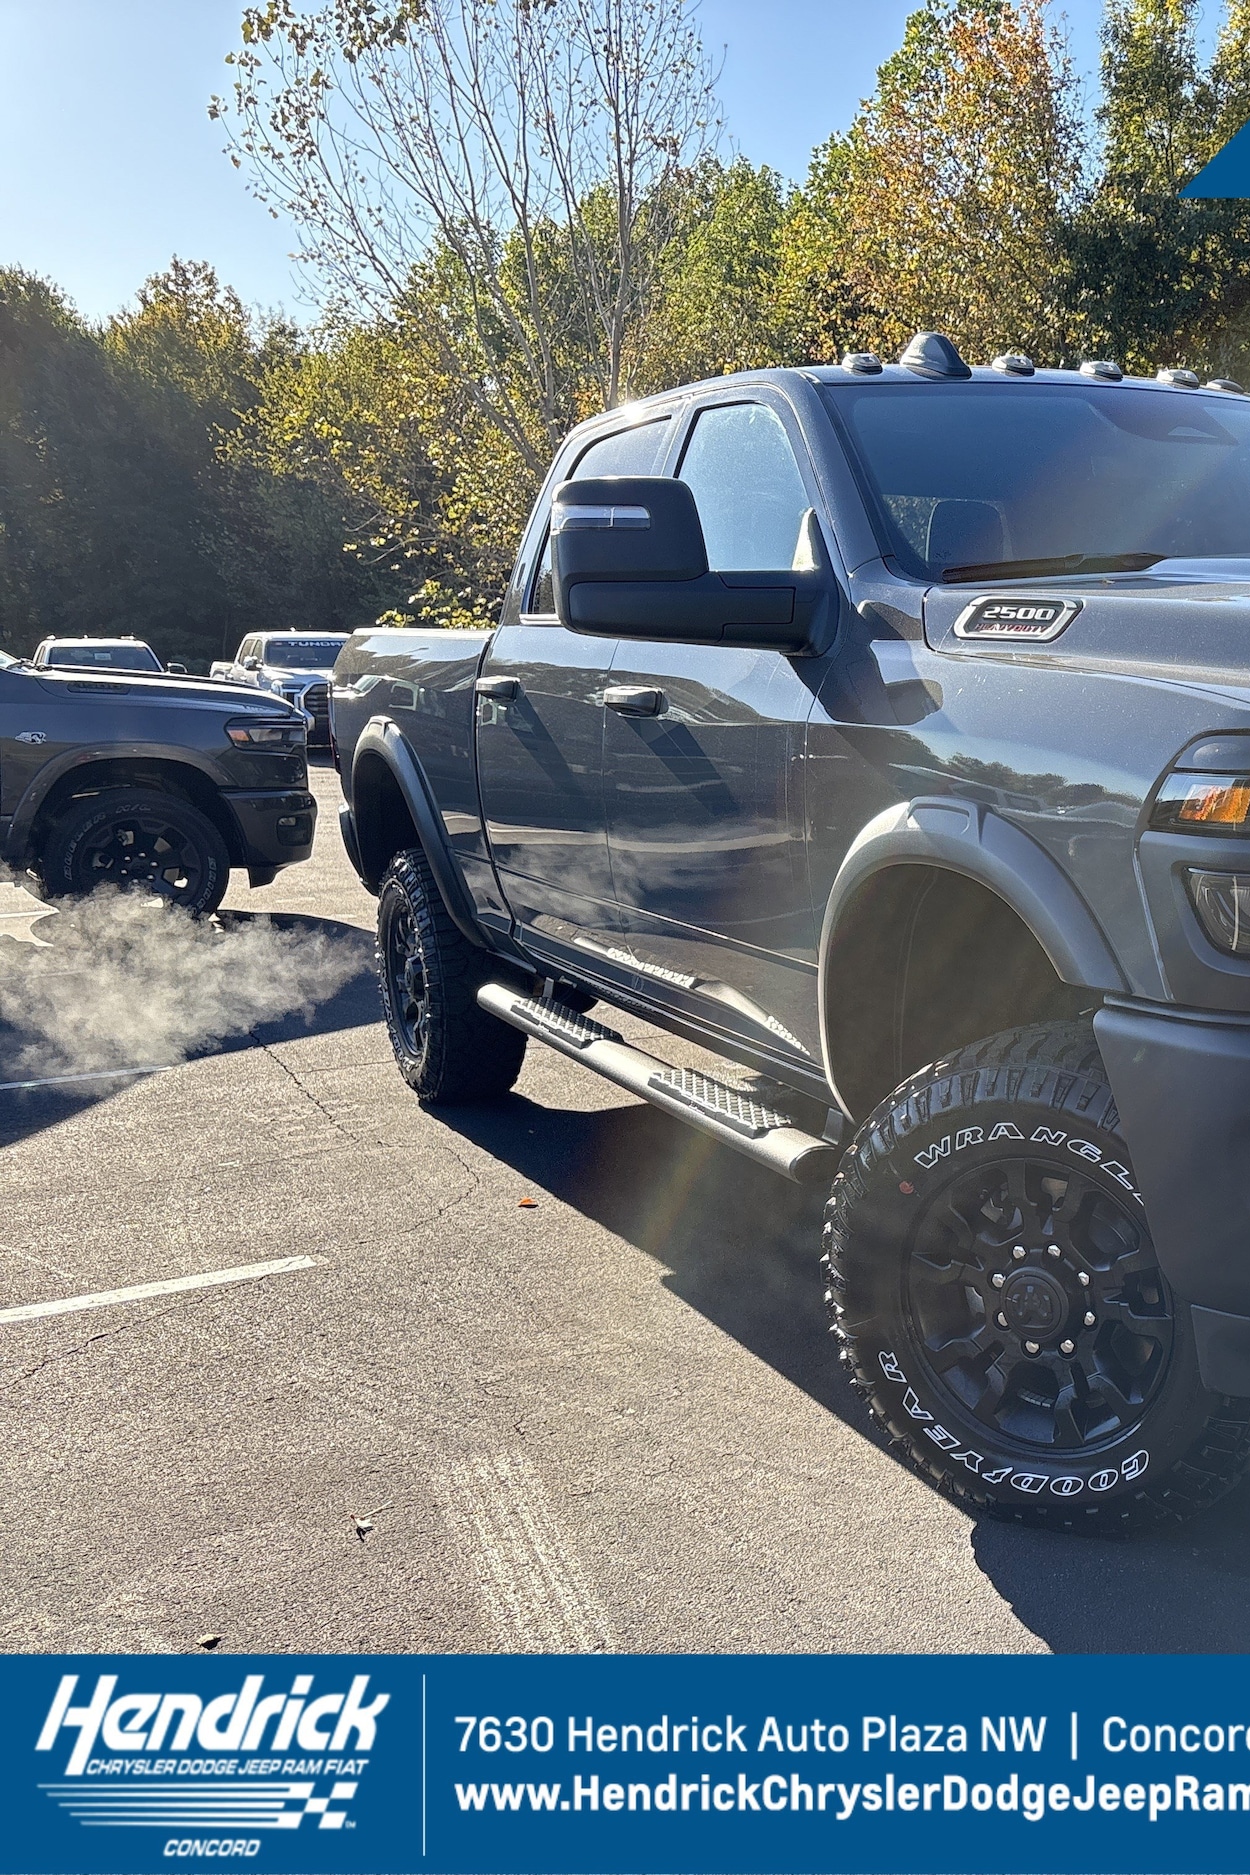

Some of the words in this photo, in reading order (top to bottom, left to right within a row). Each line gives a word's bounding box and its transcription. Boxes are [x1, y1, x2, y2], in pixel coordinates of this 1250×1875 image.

[982, 606, 1057, 620] 2500
[1012, 624, 1051, 633] DUTY
[914, 1122, 1145, 1206] WRANGL
[878, 1350, 1150, 1496] GOODYEAR
